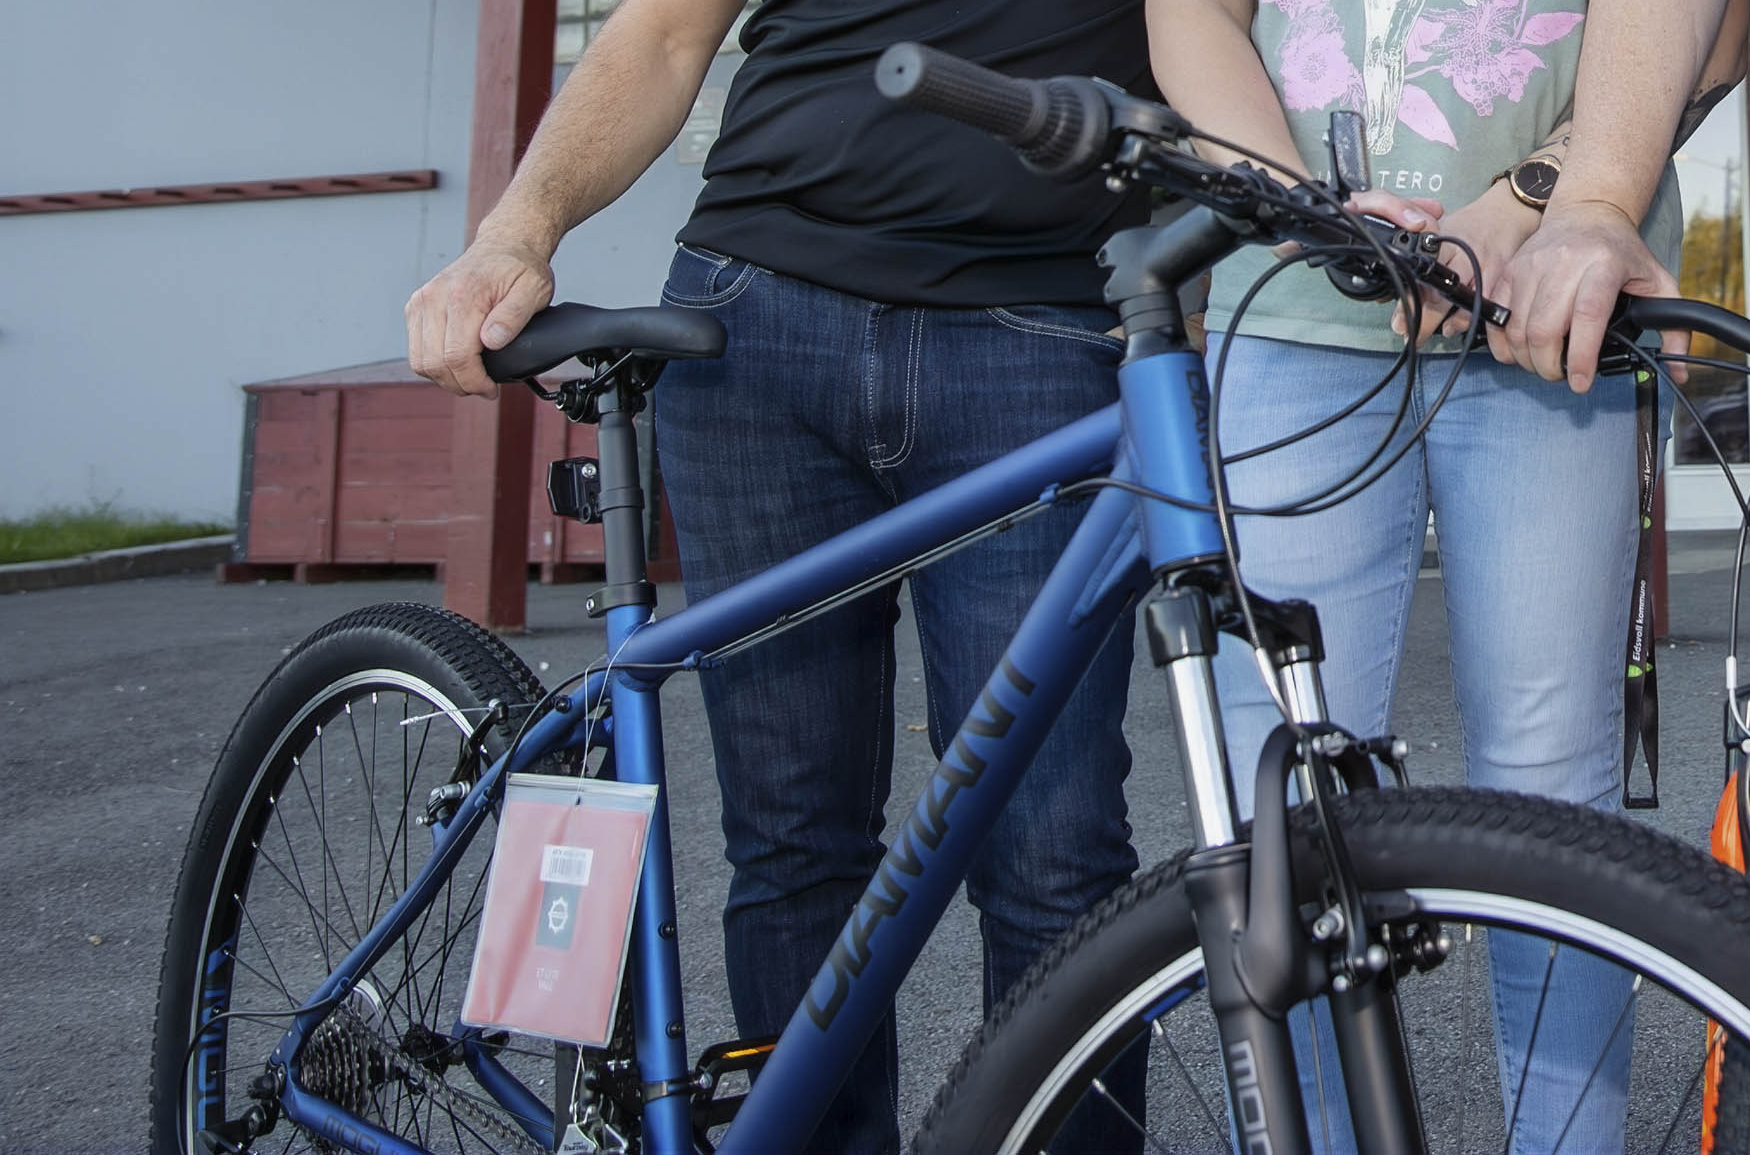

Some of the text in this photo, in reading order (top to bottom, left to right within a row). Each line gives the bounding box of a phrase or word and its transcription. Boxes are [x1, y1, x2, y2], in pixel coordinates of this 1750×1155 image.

[1377, 169, 1443, 192] TERO
[1632, 579, 1647, 662] Eidsvoll kommune
